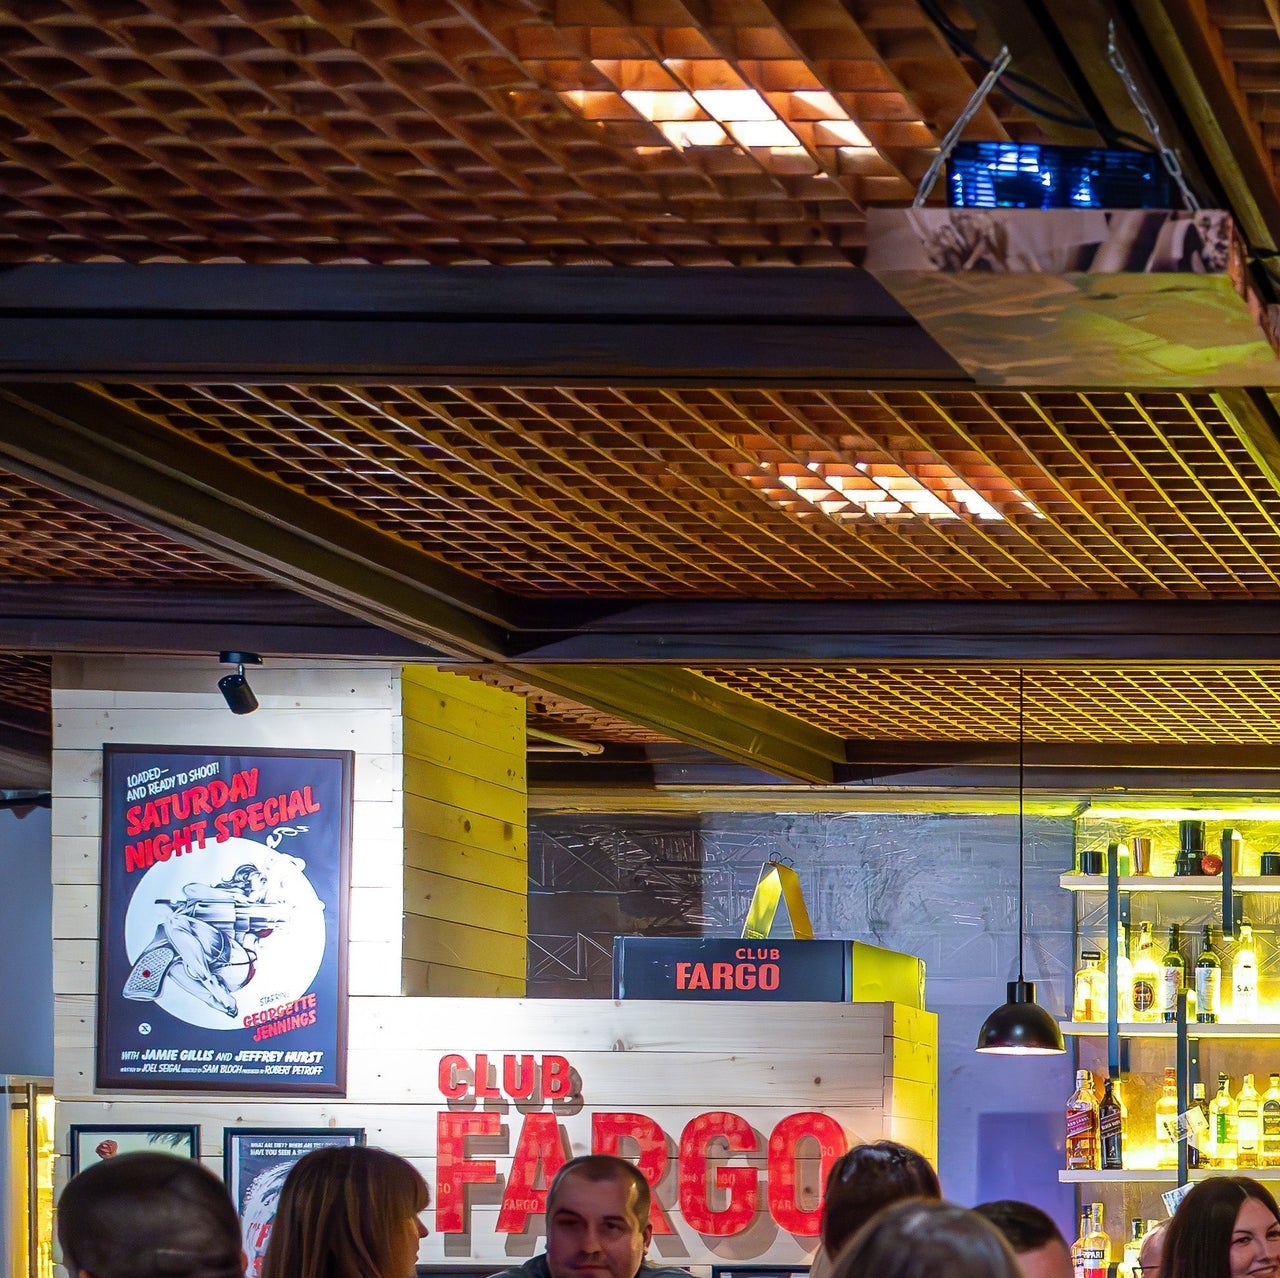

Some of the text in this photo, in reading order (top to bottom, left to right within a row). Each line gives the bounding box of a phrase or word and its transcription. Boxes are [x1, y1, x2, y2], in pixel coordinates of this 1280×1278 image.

[127, 762, 220, 802] AND READY TO SHOOT!
[126, 768, 259, 837] SATURDAY
[125, 786, 321, 873] NIGHT SPECIAL
[735, 947, 781, 960] CLUB
[676, 962, 781, 991] FARGO
[243, 992, 317, 1028] GEORGETTE
[253, 1009, 317, 1042] JENNINGS
[121, 1049, 324, 1064] WITH JAMIE GILLIS AND JEFFREY HURST
[142, 1063, 158, 1073] JOEL
[202, 1064, 219, 1073] SAM
[265, 1065, 292, 1075] ROBERT
[292, 1066, 324, 1075] PETROFF
[438, 1054, 573, 1099] CLUB
[436, 1111, 850, 1237] FARGO
